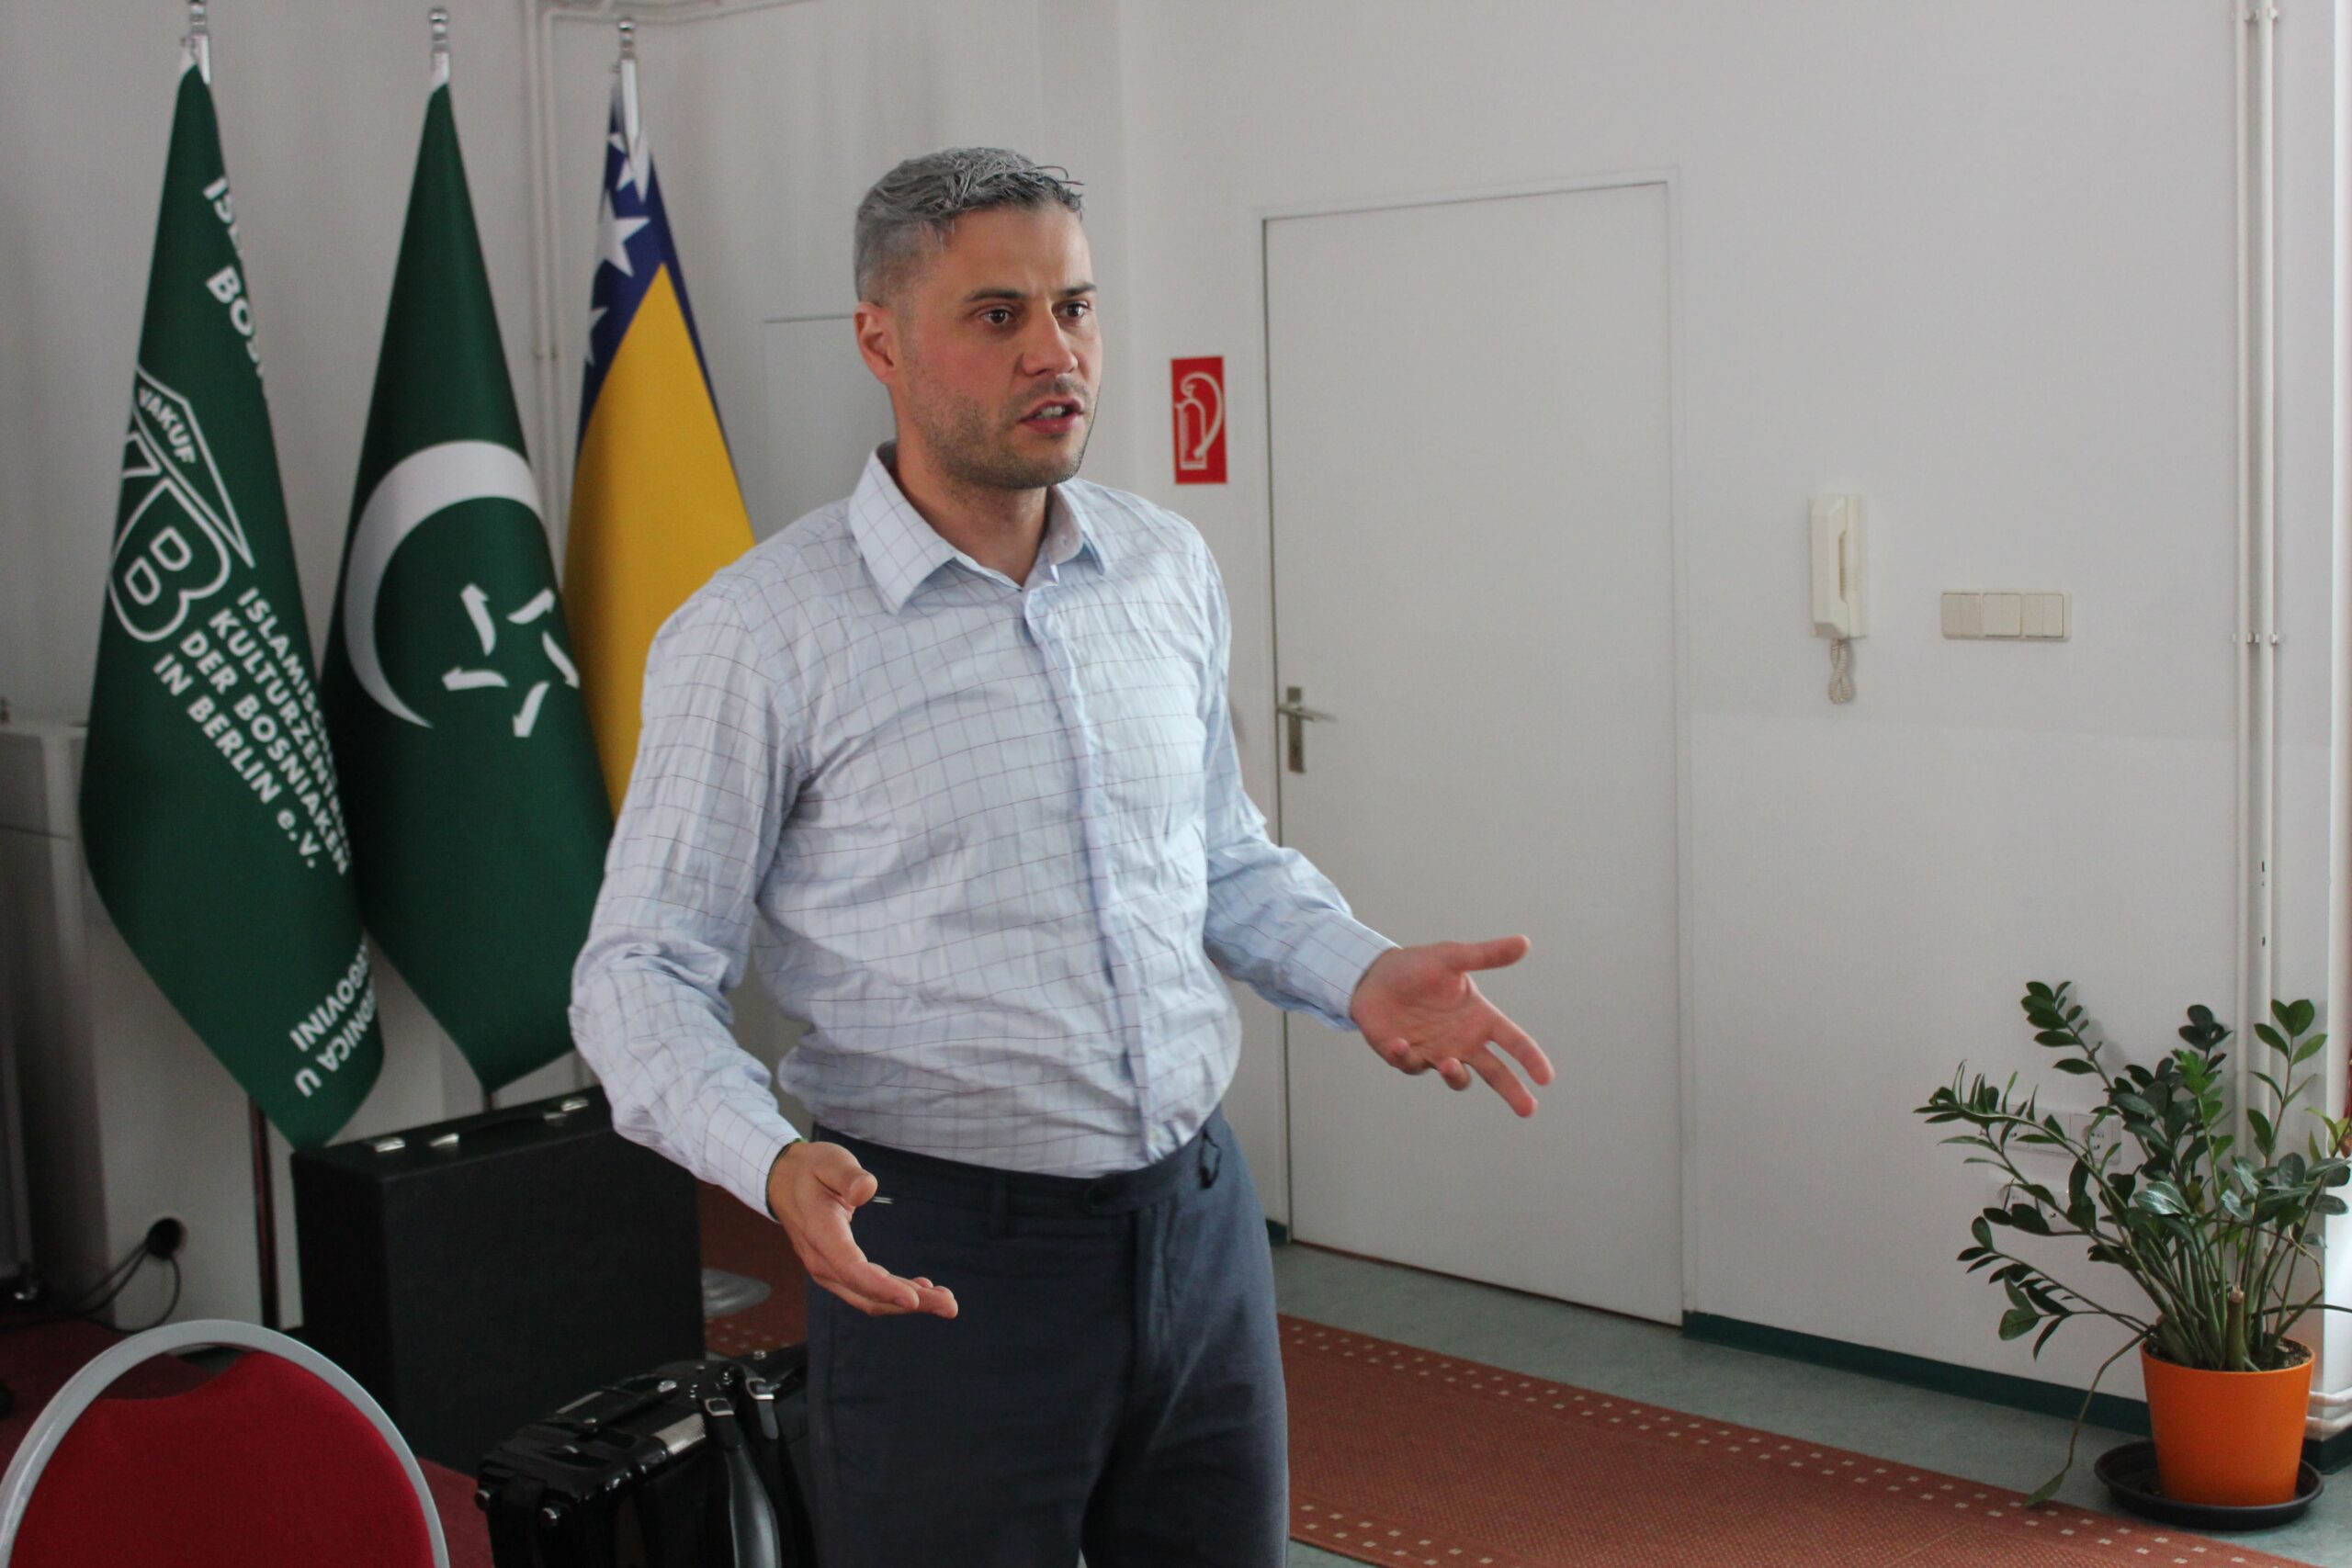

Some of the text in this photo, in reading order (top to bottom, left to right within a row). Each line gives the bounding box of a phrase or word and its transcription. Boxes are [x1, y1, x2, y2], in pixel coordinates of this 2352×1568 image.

[153, 653, 321, 869] IN BERLIN e.V.
[179, 629, 348, 875] DER BOSNIAKEN
[294, 1067, 322, 1098] U
